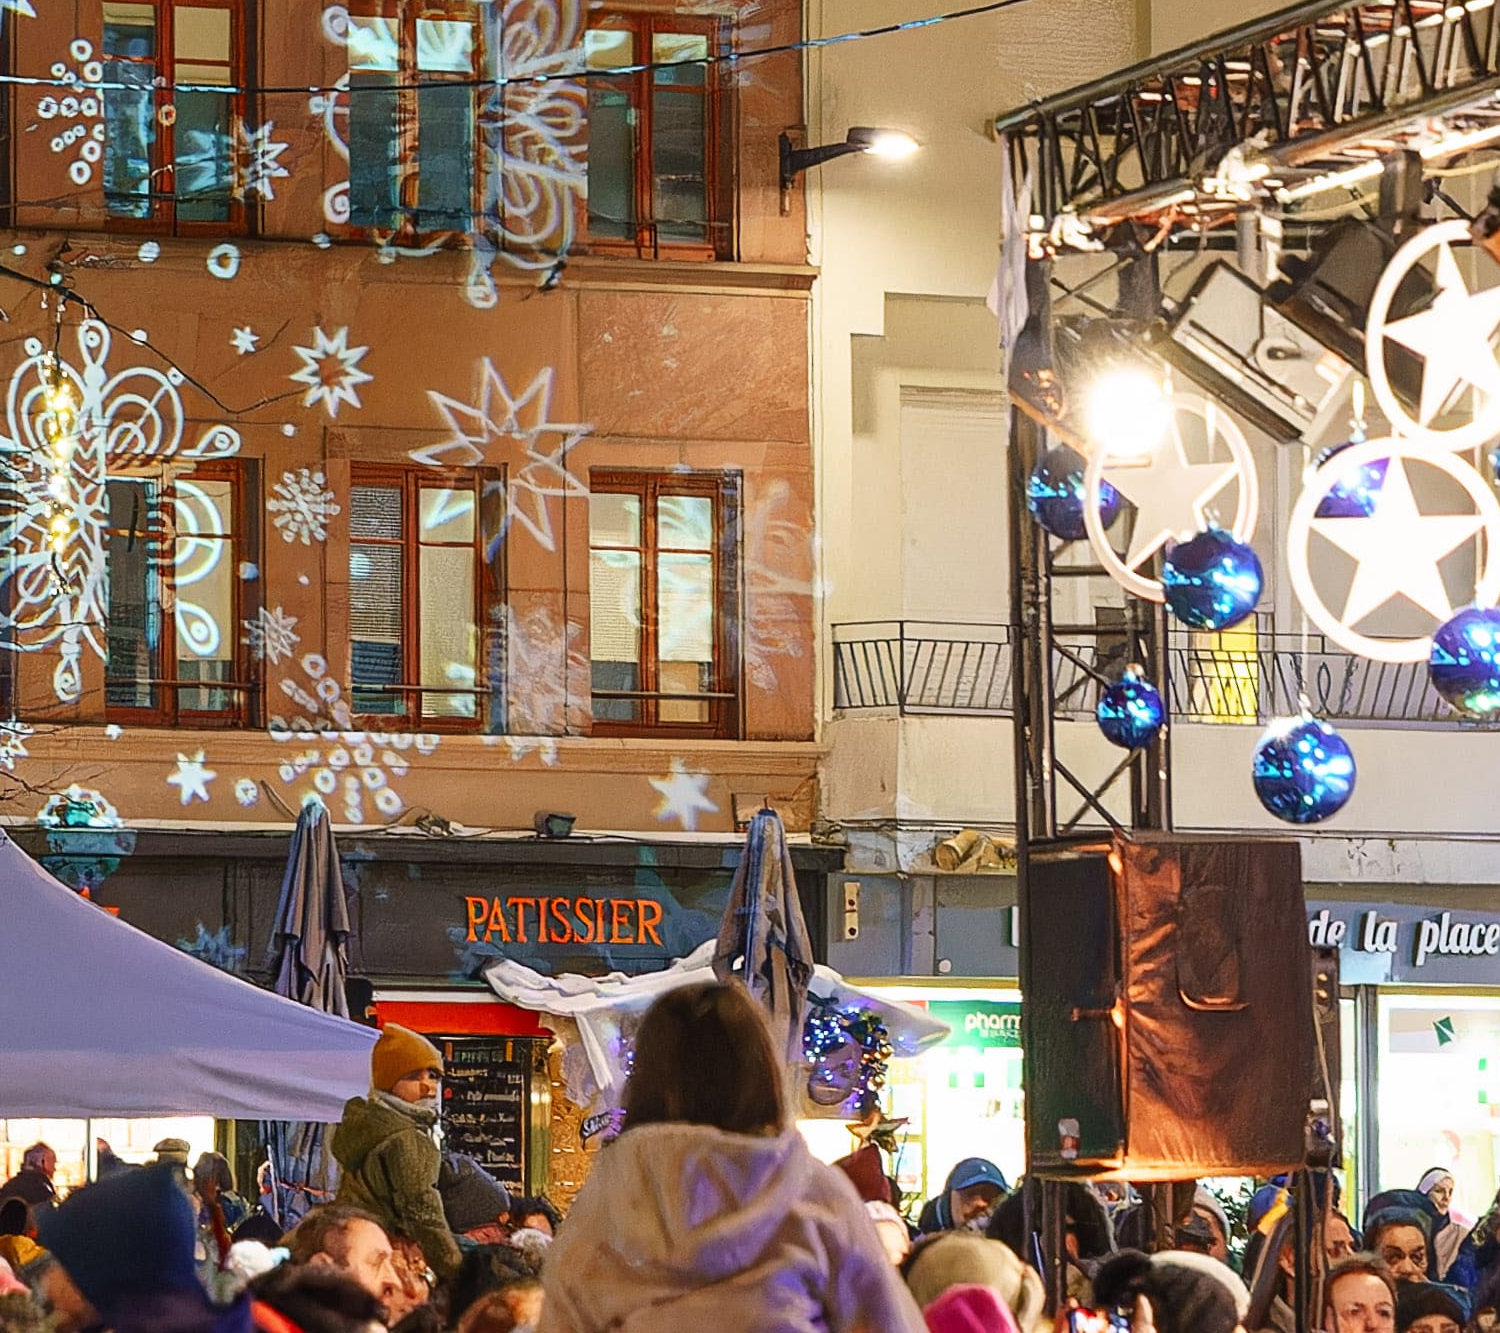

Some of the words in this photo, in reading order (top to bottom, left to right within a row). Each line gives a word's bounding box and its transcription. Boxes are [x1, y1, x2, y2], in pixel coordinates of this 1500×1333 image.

[465, 896, 664, 945] PATISSIER
[1308, 909, 1346, 947] de
[1362, 910, 1398, 952] la
[1415, 912, 1500, 966] place
